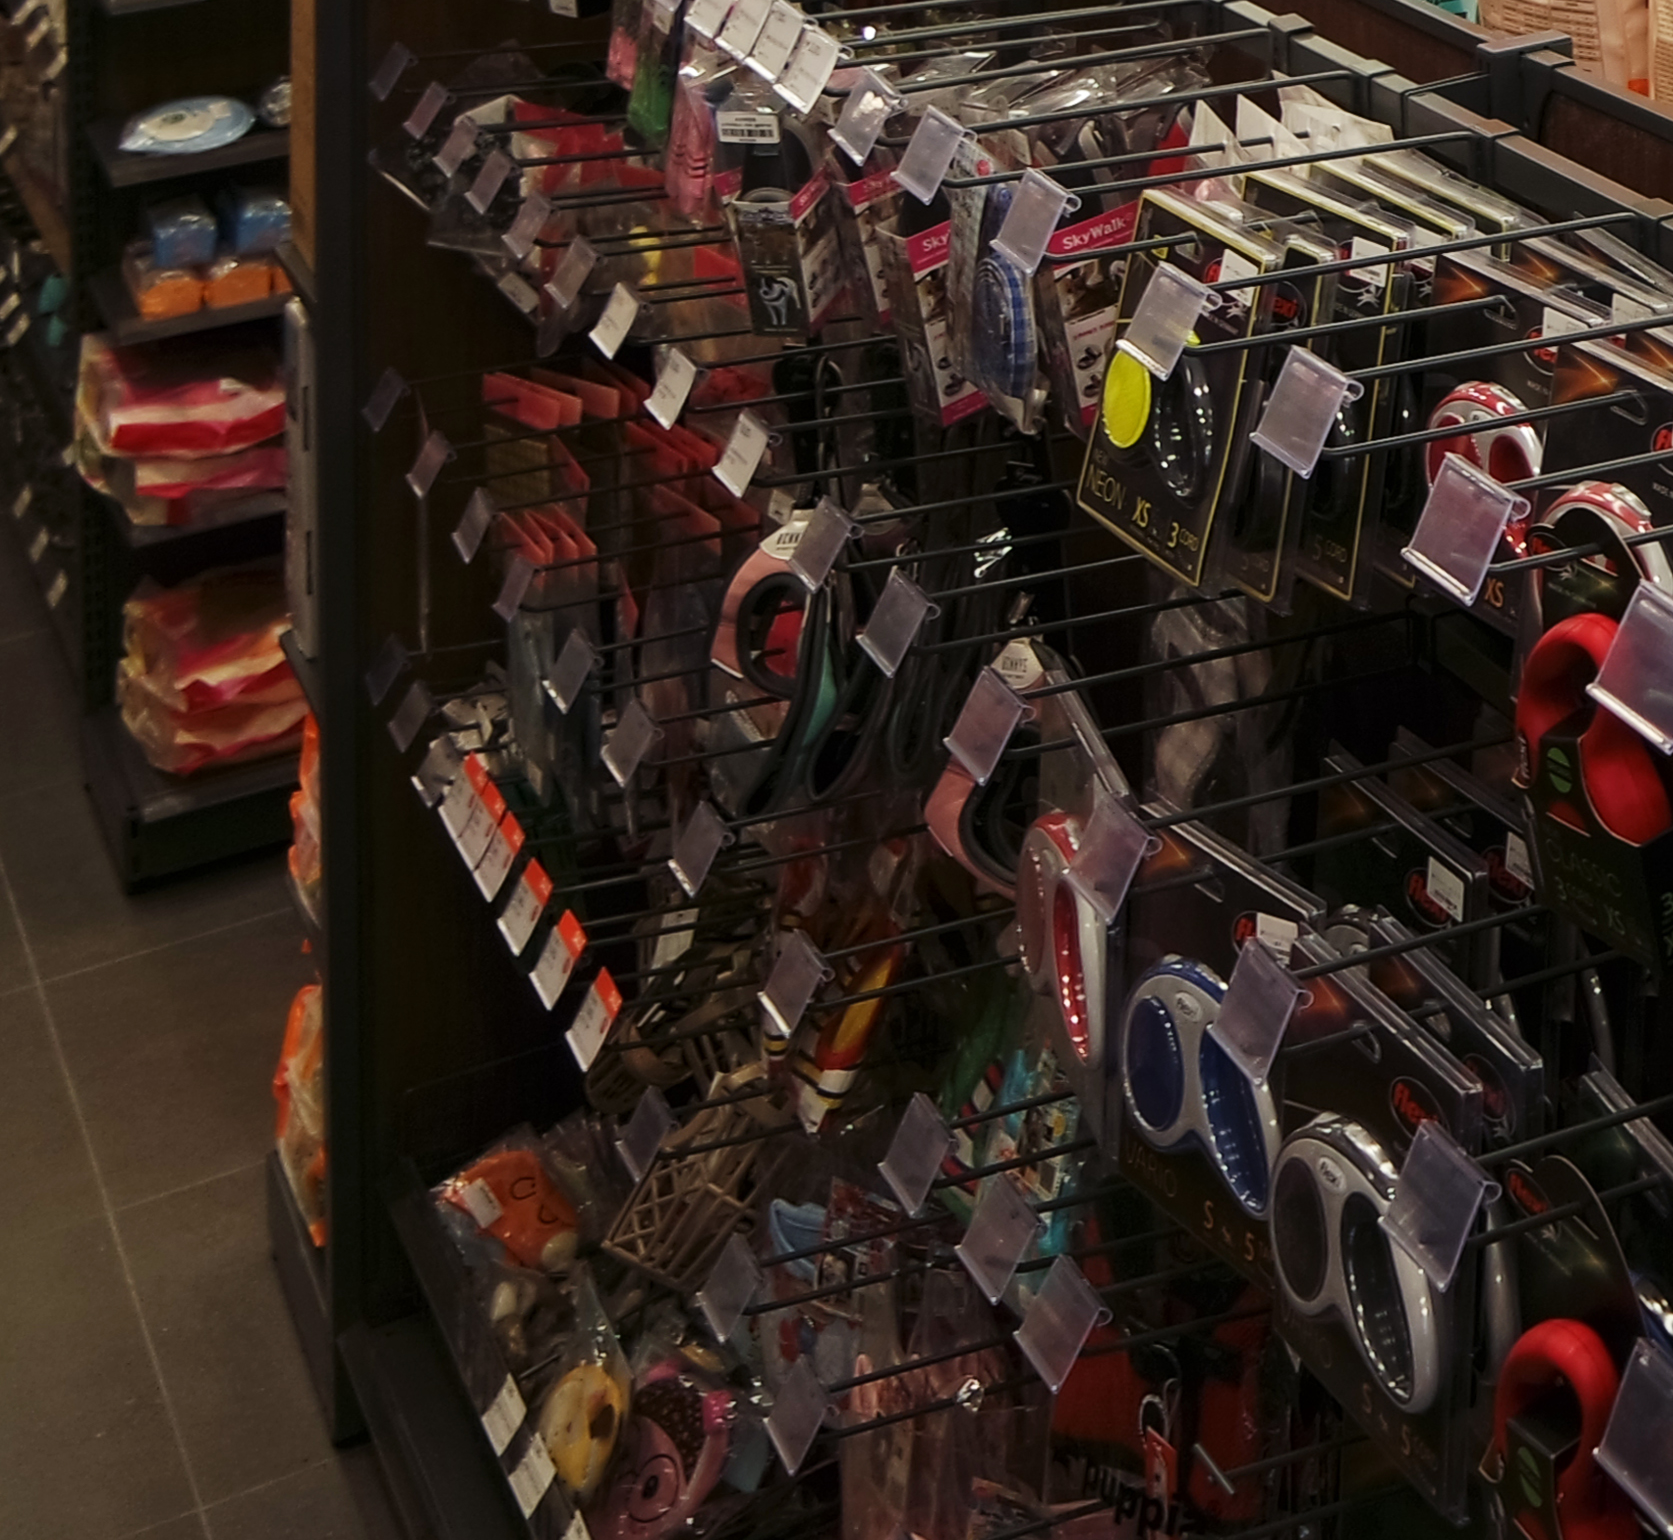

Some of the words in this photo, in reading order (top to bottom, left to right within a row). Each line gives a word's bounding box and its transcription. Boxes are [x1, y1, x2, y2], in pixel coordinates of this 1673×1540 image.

[1062, 216, 1127, 251] SkyWalk
[1085, 463, 1127, 510] NEON
[1131, 496, 1152, 528] XS
[1167, 521, 1179, 548] 3
